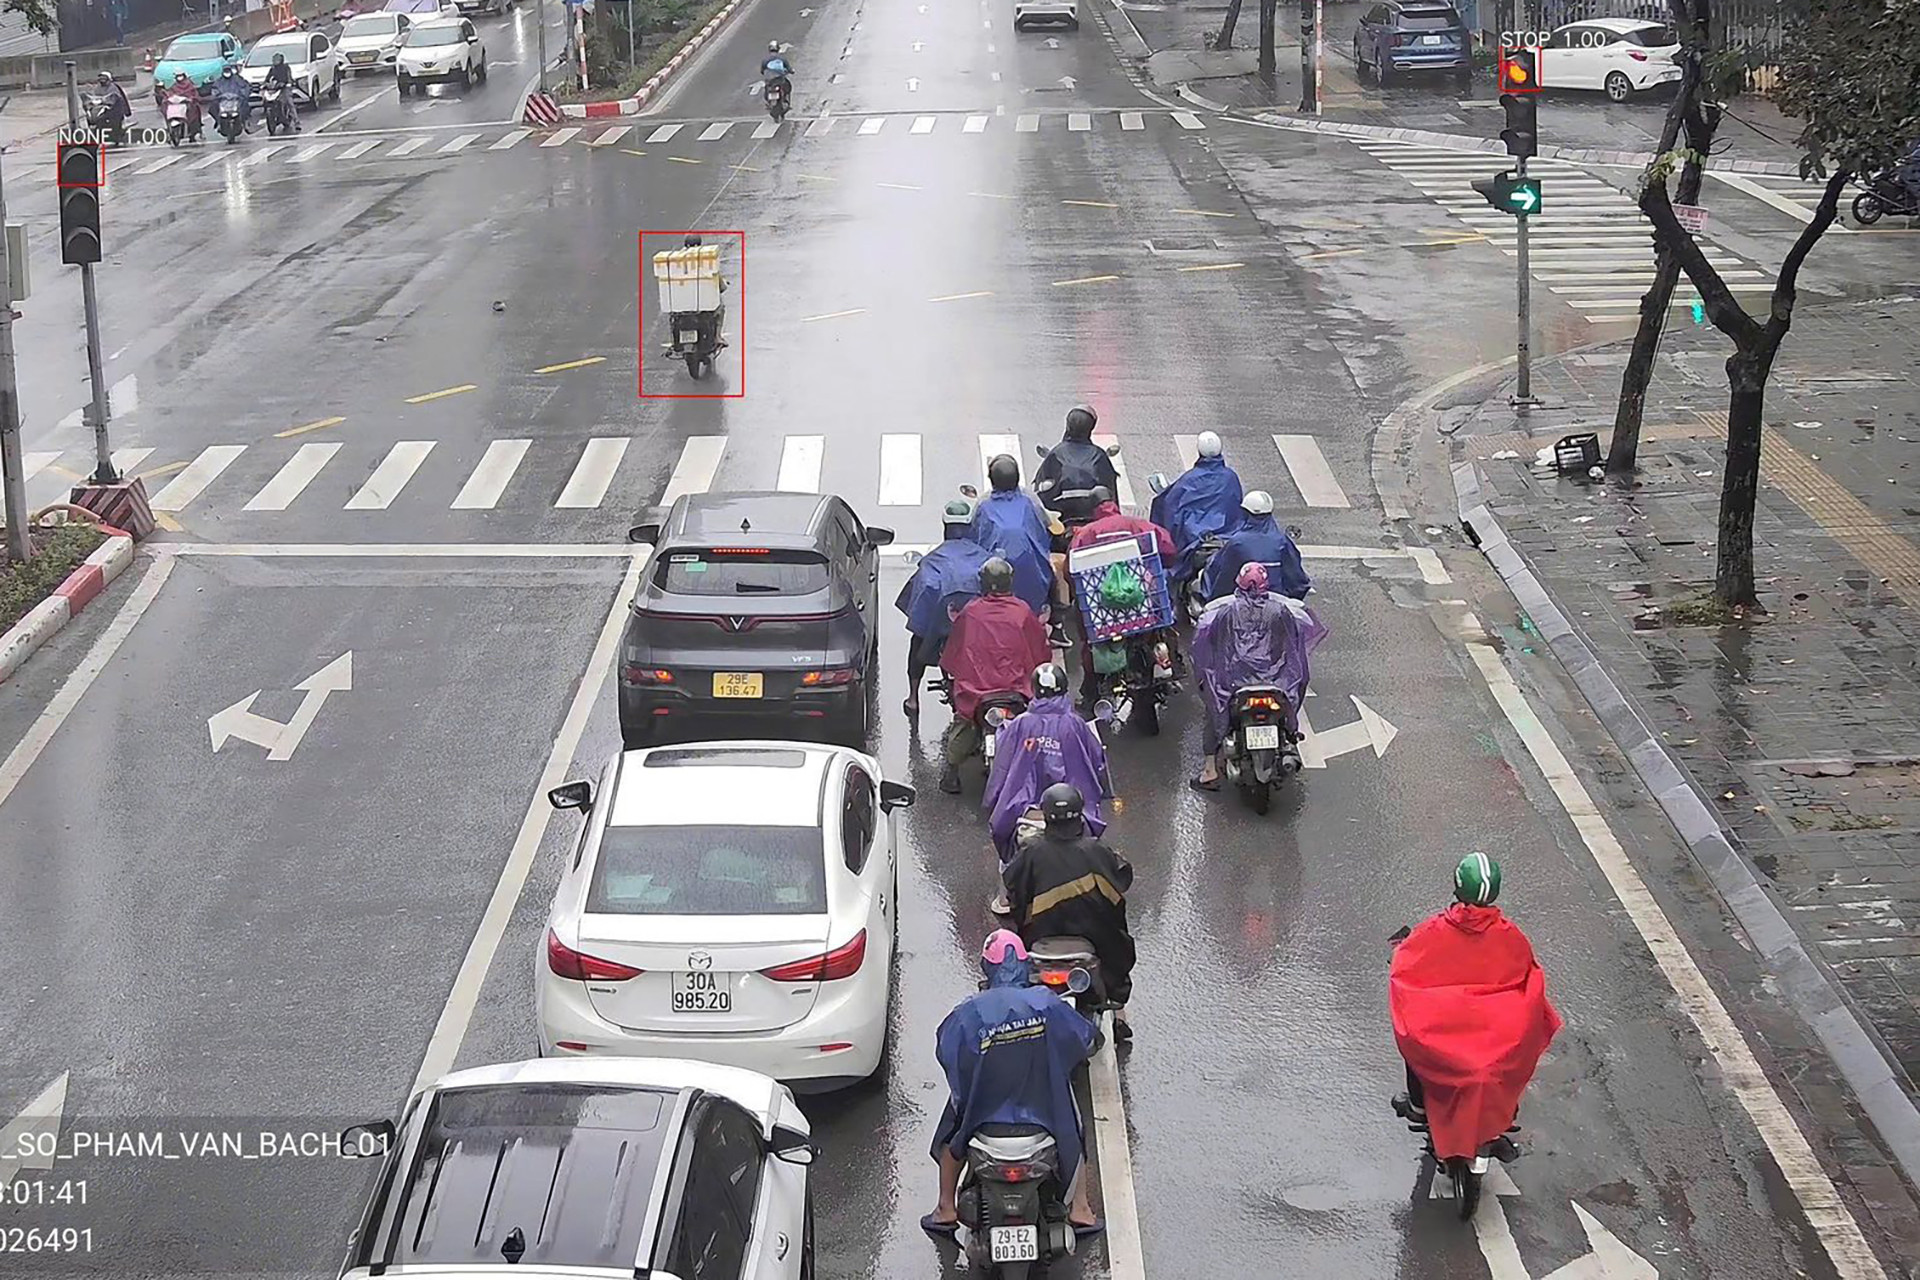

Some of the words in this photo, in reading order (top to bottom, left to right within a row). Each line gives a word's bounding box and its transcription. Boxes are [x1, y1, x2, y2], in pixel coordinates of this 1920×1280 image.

[727, 674, 748, 685] 29E
[720, 685, 757, 696] 136.47
[686, 972, 716, 990] 30A
[675, 991, 728, 1009] 985.20
[997, 1229, 1030, 1244] 29-E2
[994, 1244, 1035, 1259] 803.60
